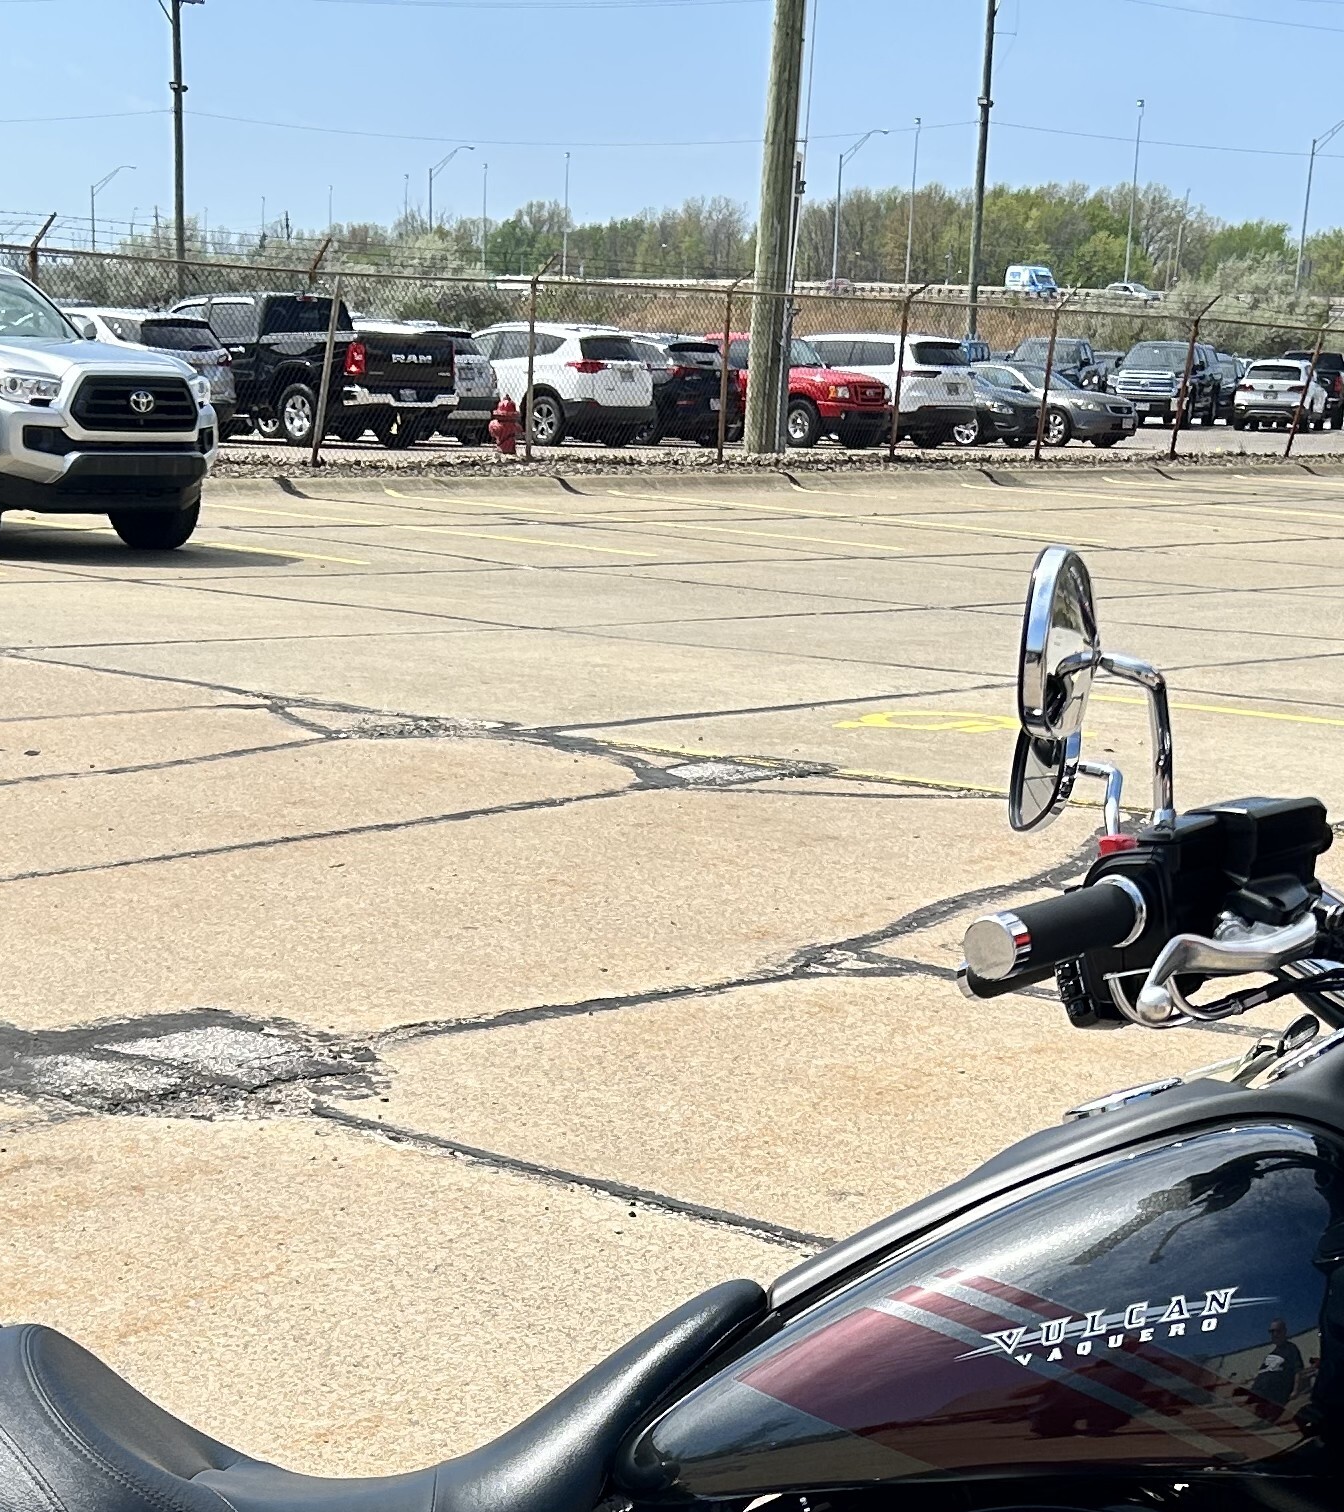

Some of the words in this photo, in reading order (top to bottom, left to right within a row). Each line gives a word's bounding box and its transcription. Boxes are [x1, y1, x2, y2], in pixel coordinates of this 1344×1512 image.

[391, 353, 433, 364] RAM
[981, 1286, 1239, 1355] VULCAN
[1014, 1318, 1219, 1367] VAQUERO
